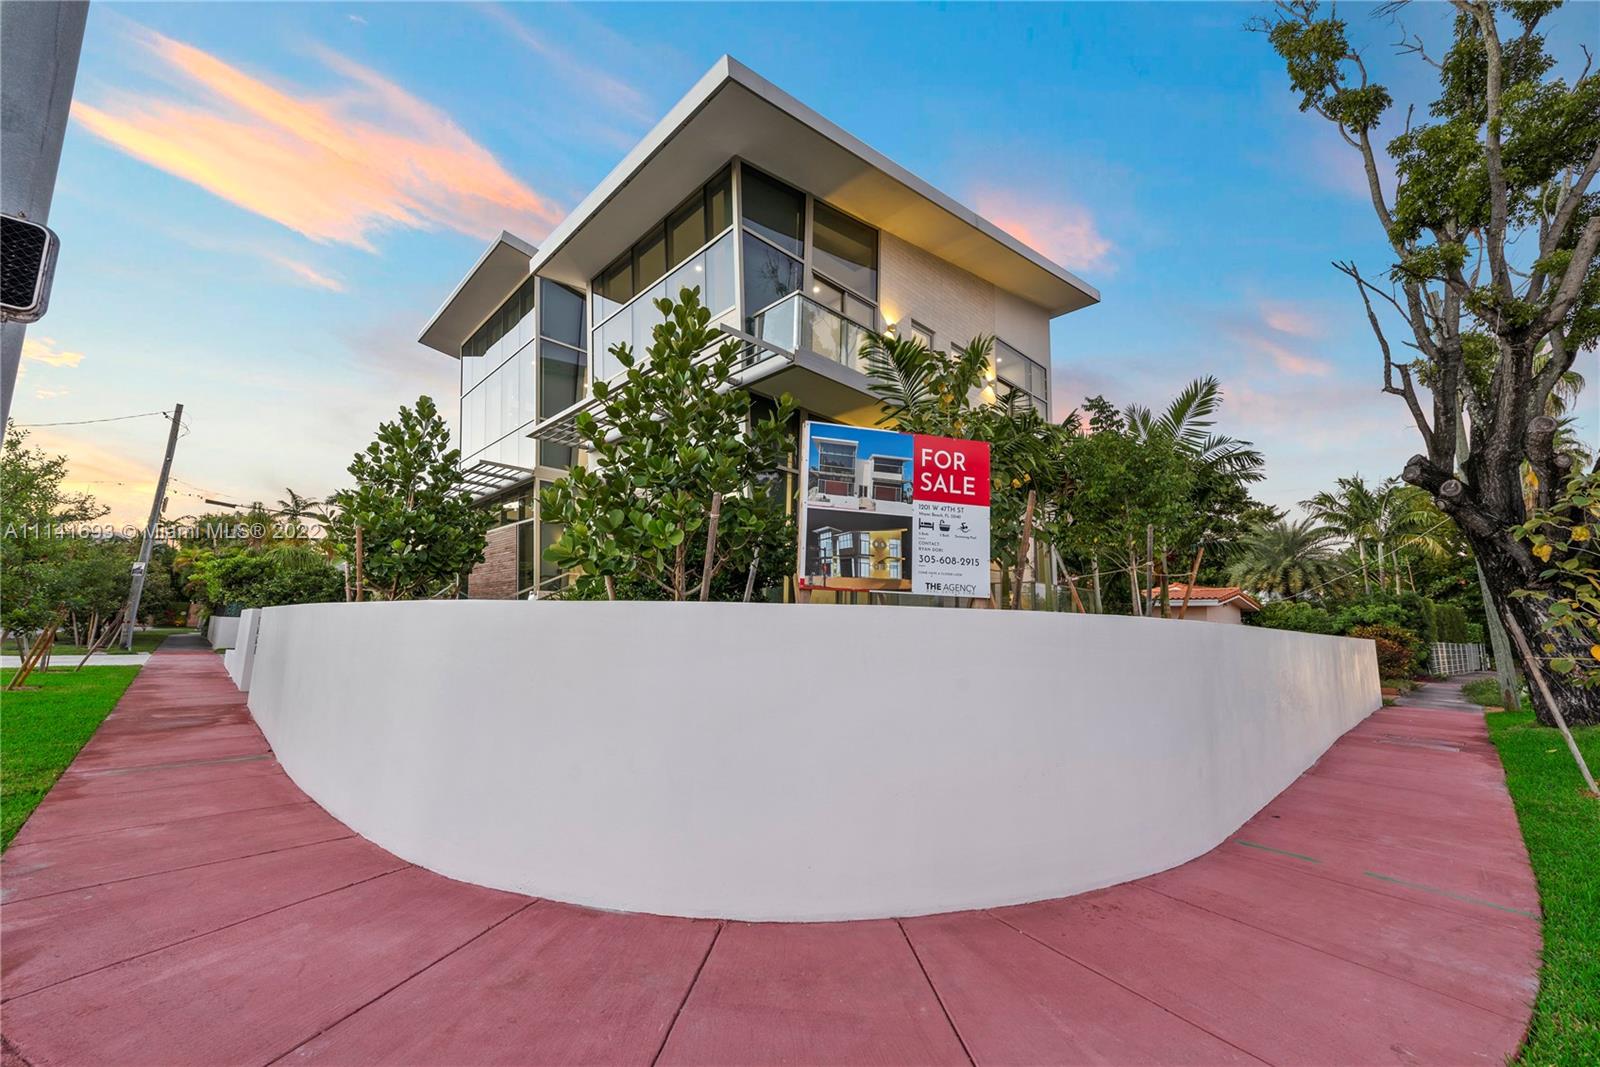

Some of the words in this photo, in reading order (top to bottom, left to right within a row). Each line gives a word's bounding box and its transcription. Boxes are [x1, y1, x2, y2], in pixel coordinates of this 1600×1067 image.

[921, 448, 966, 472] FOR
[920, 472, 976, 496] SALE
[918, 555, 980, 566] 305-608-2915
[925, 582, 942, 591] THE
[943, 583, 977, 593] AGENCY
